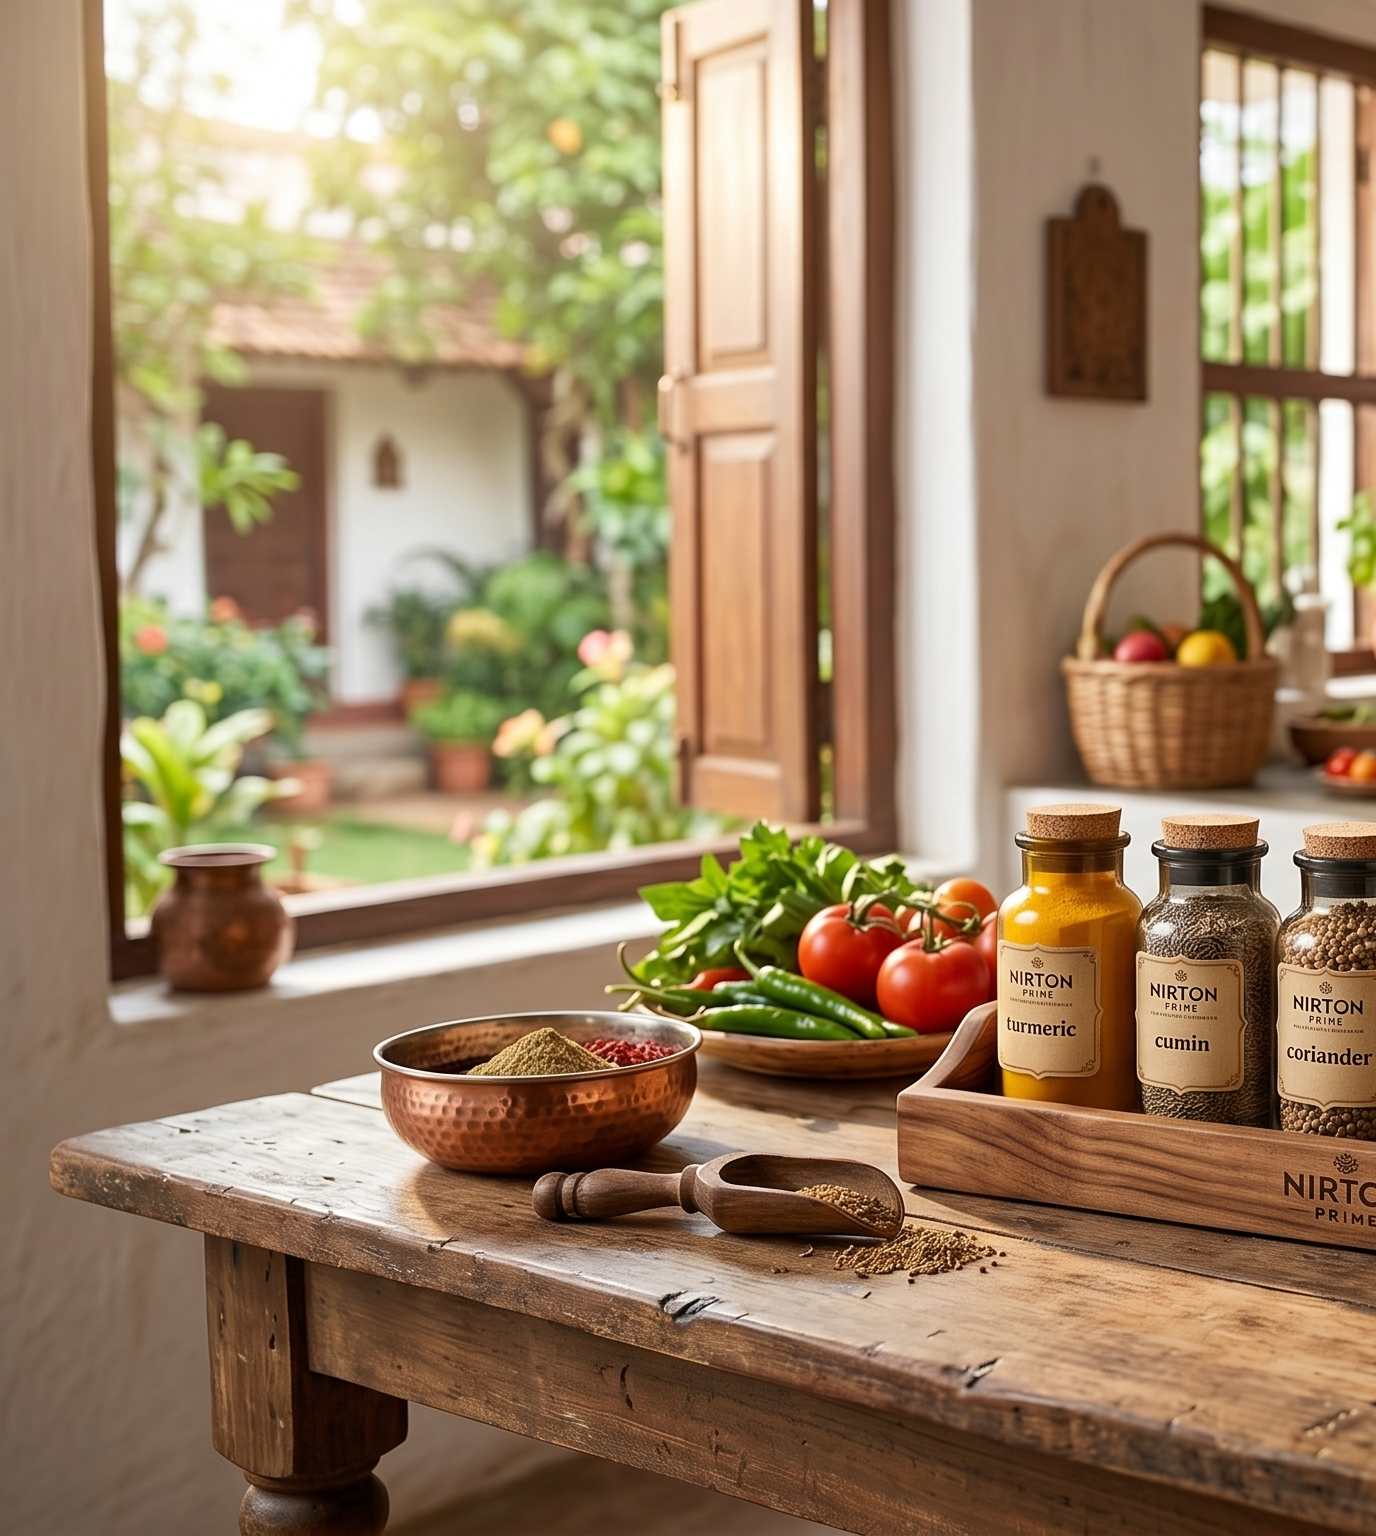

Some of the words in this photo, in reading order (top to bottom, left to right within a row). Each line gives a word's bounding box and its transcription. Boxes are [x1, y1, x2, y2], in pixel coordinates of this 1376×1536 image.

[1010, 970, 1073, 989] NIRTON
[1150, 983, 1218, 1002] NIRTON
[1293, 995, 1363, 1015] NIRTON
[1007, 1017, 1076, 1036] turmeric
[1309, 1015, 1343, 1026] PRIME
[1155, 1035, 1210, 1052] cumin
[1287, 1045, 1373, 1066] coriander
[1315, 1207, 1376, 1227] PRIME
